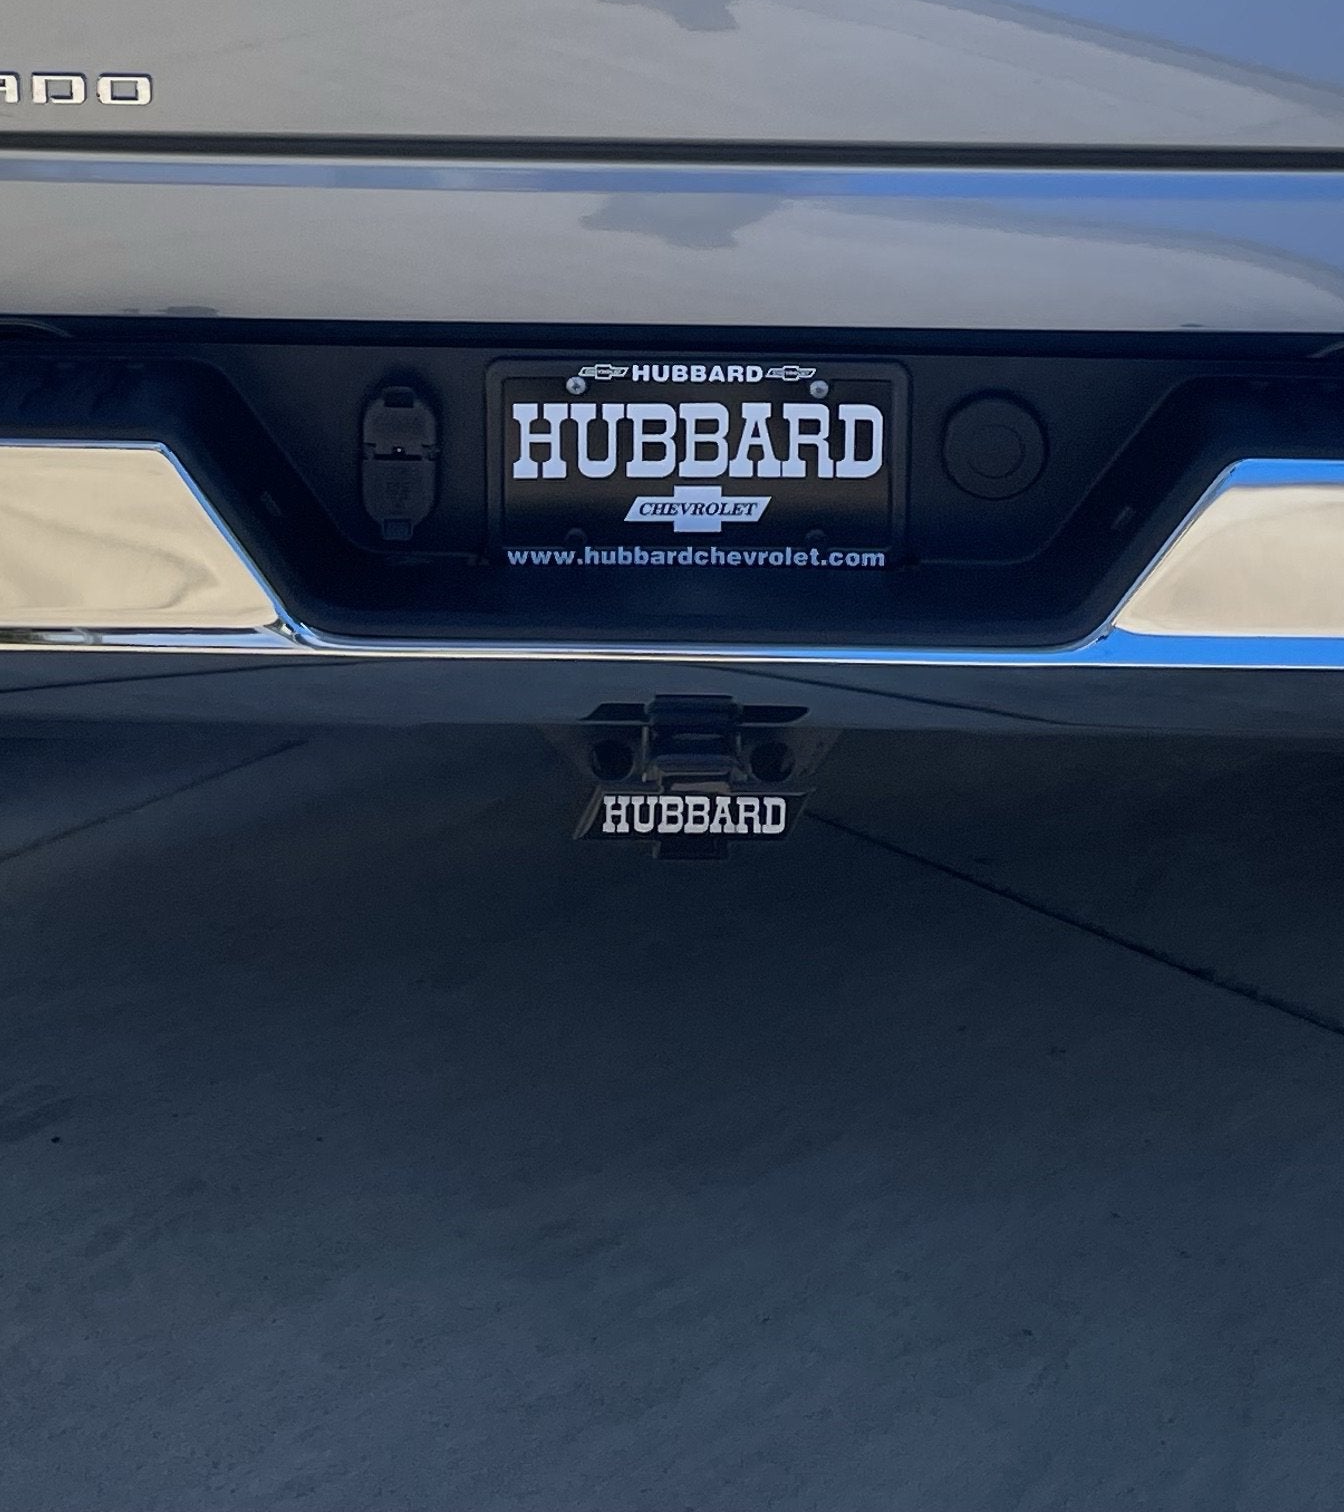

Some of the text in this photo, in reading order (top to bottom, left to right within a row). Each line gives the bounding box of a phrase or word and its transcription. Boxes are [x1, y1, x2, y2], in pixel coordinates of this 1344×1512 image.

[631, 364, 764, 383] HUBBARD
[512, 402, 884, 478] HUBBARD
[638, 501, 758, 517] CHEVROLET
[506, 546, 886, 567] www.hubbardchevrolet.com
[602, 795, 787, 834] HUBBARD
